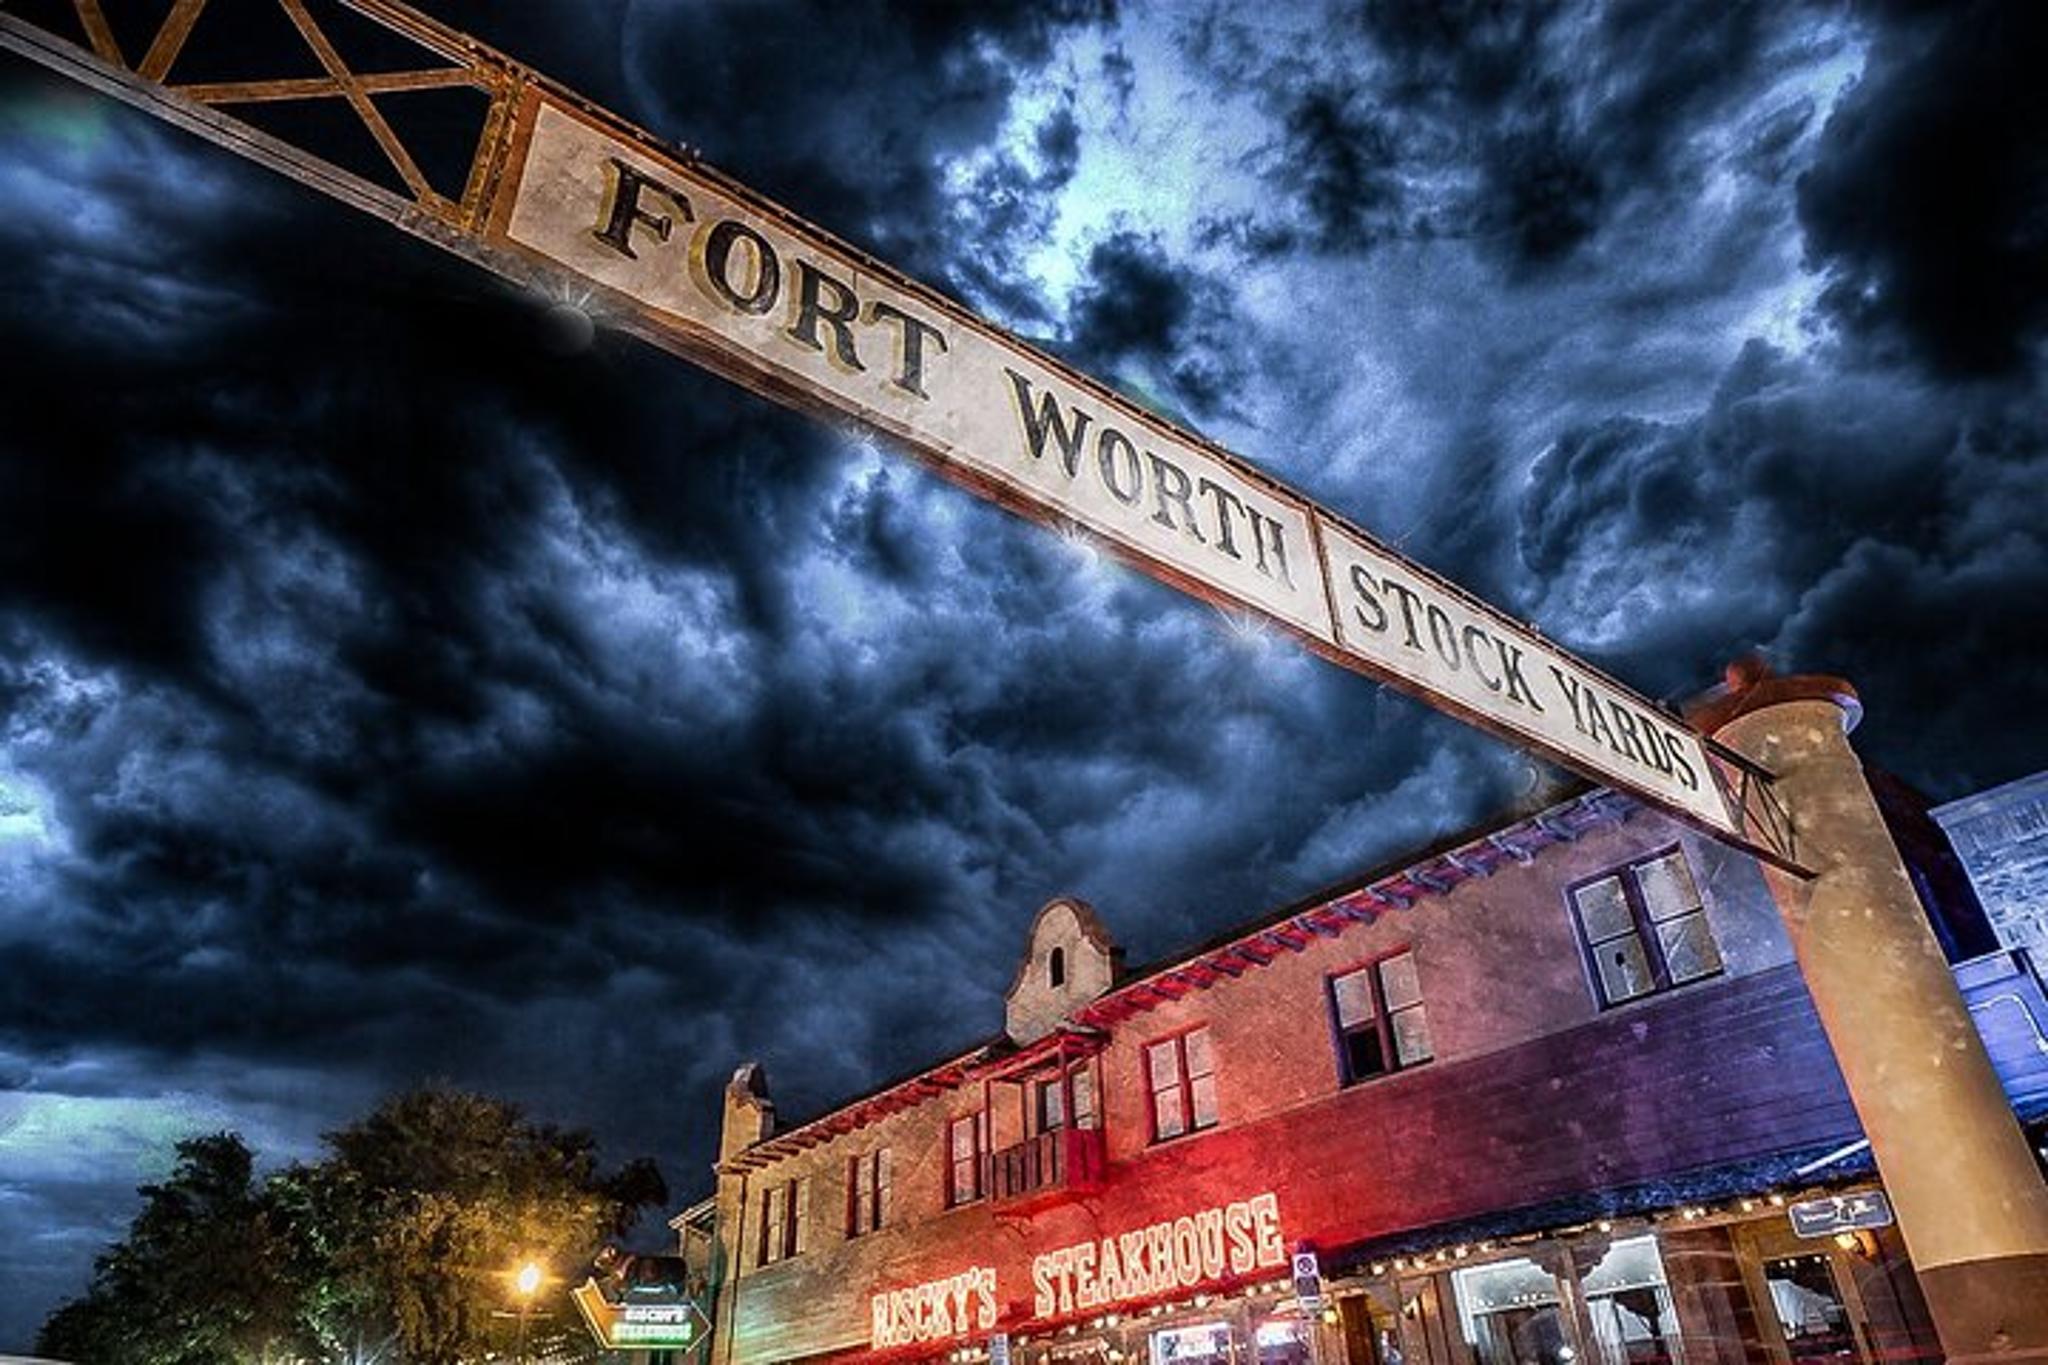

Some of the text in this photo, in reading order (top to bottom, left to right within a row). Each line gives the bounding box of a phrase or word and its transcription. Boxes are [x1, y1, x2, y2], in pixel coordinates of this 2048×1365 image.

[591, 157, 1698, 790] FORT WORTH STOCK YARDS
[1033, 1193, 1286, 1318] STEAKHOUSE
